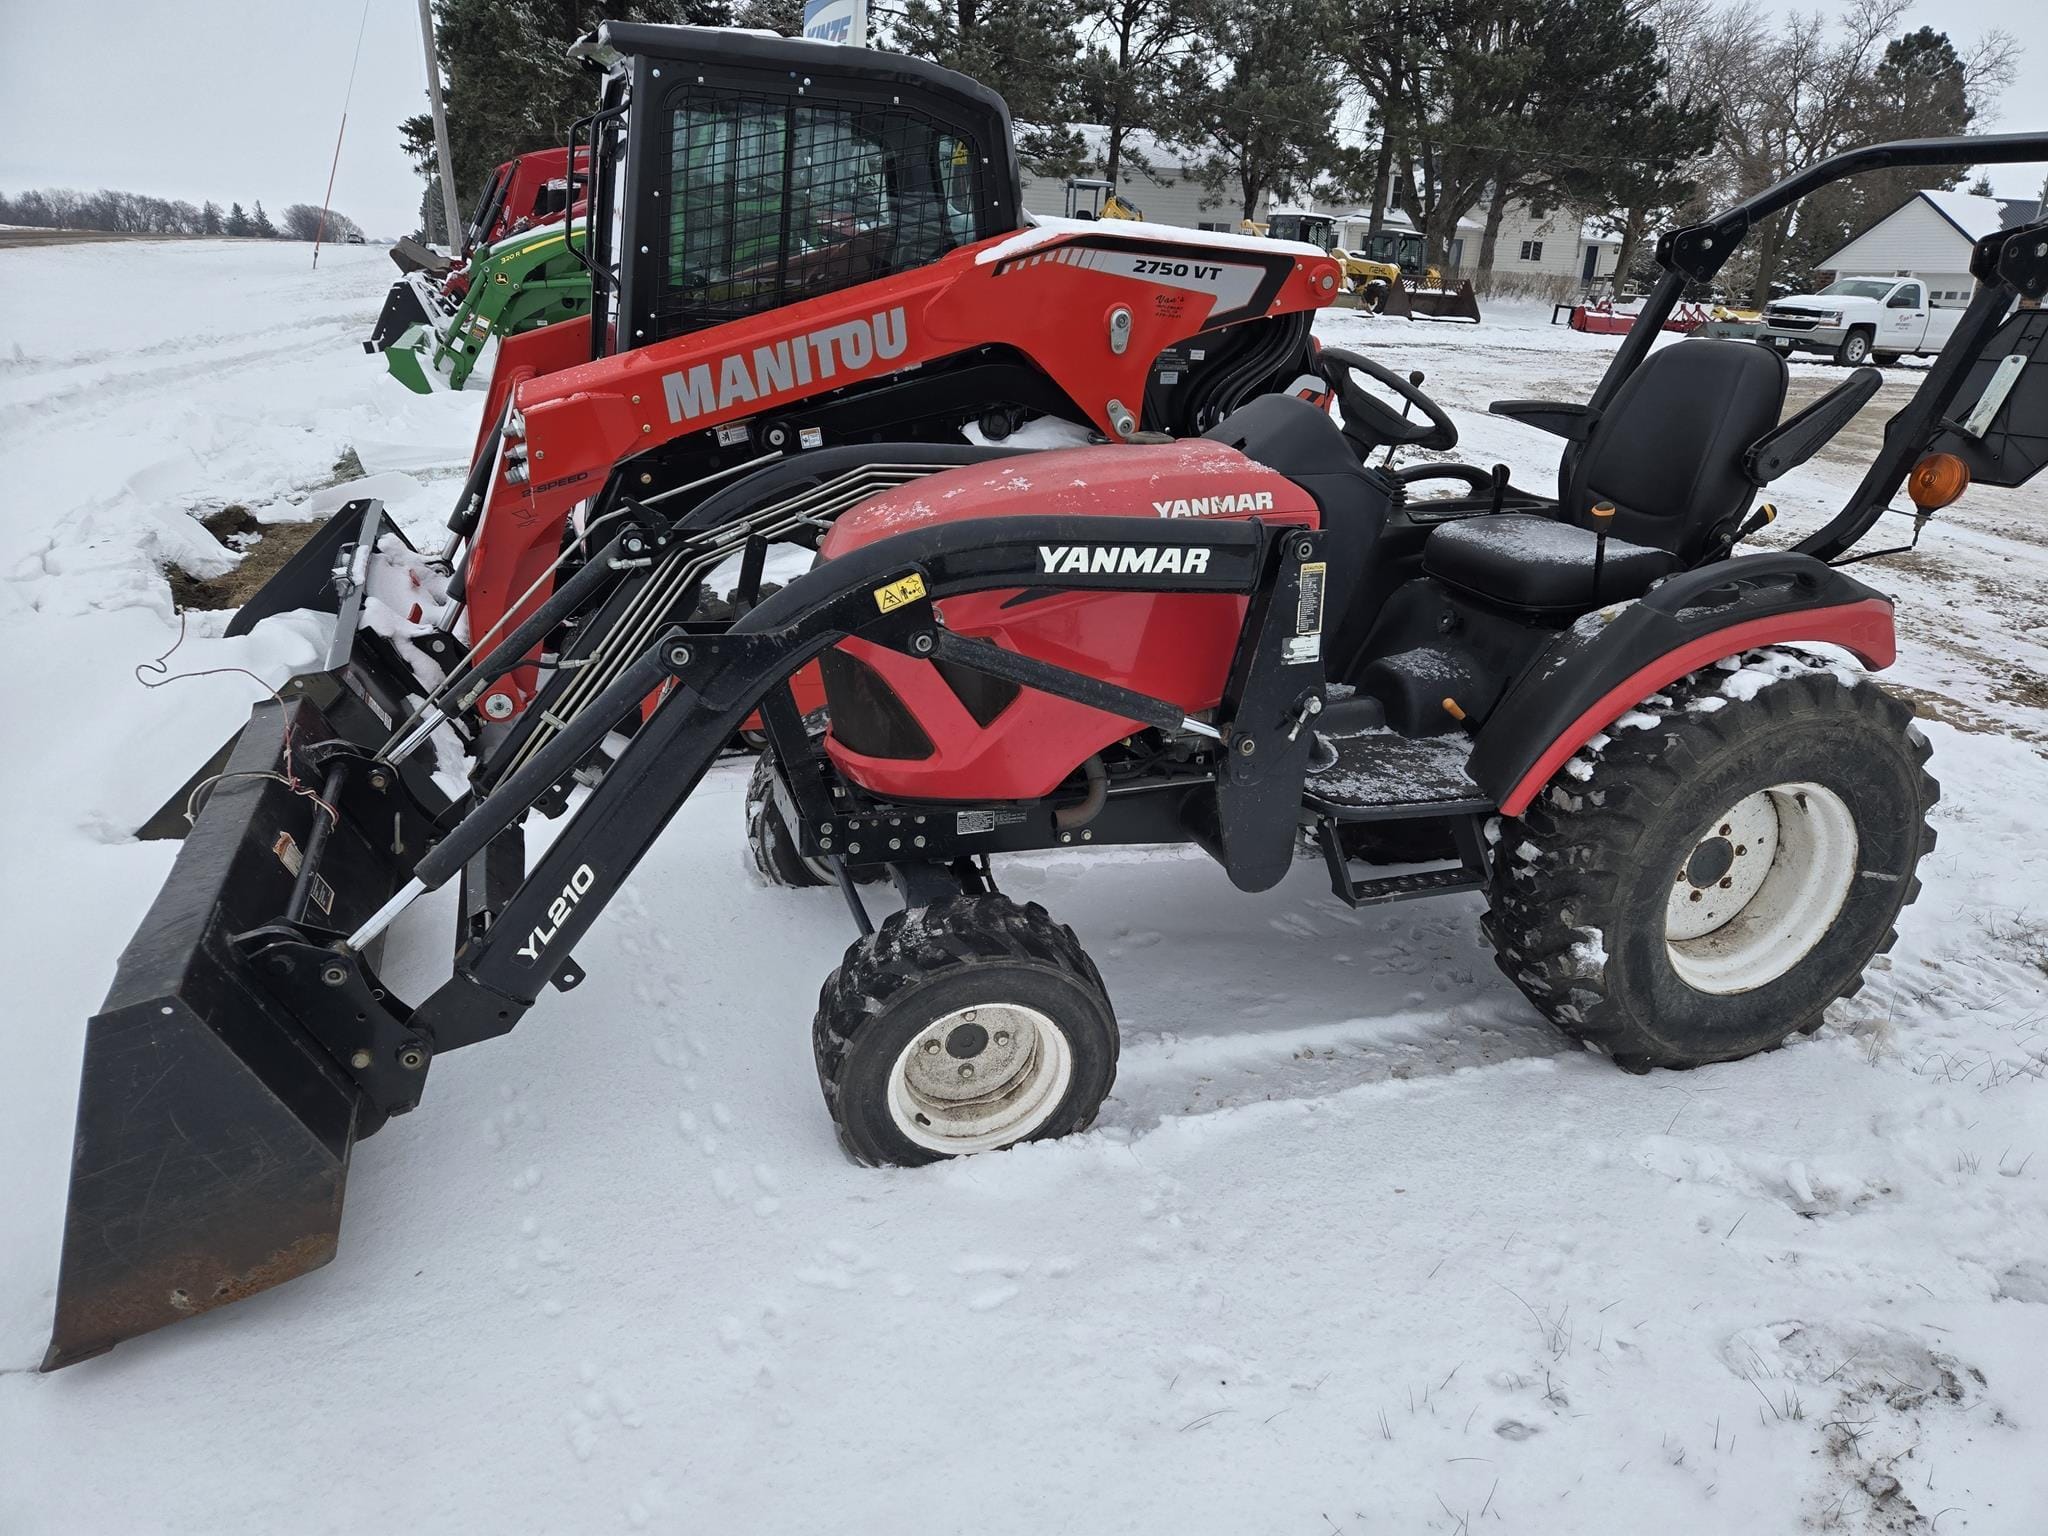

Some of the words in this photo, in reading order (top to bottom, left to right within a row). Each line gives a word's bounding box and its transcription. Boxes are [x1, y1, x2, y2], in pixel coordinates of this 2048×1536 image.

[500, 253, 515, 265] 320
[1132, 259, 1189, 277] 2750
[1194, 265, 1223, 280] VT
[661, 306, 908, 424] MANITOU
[521, 471, 589, 498] 2-SPEED
[1152, 491, 1273, 519] YANMAR
[1039, 546, 1211, 574] YANMAR
[516, 863, 595, 960] YL210
